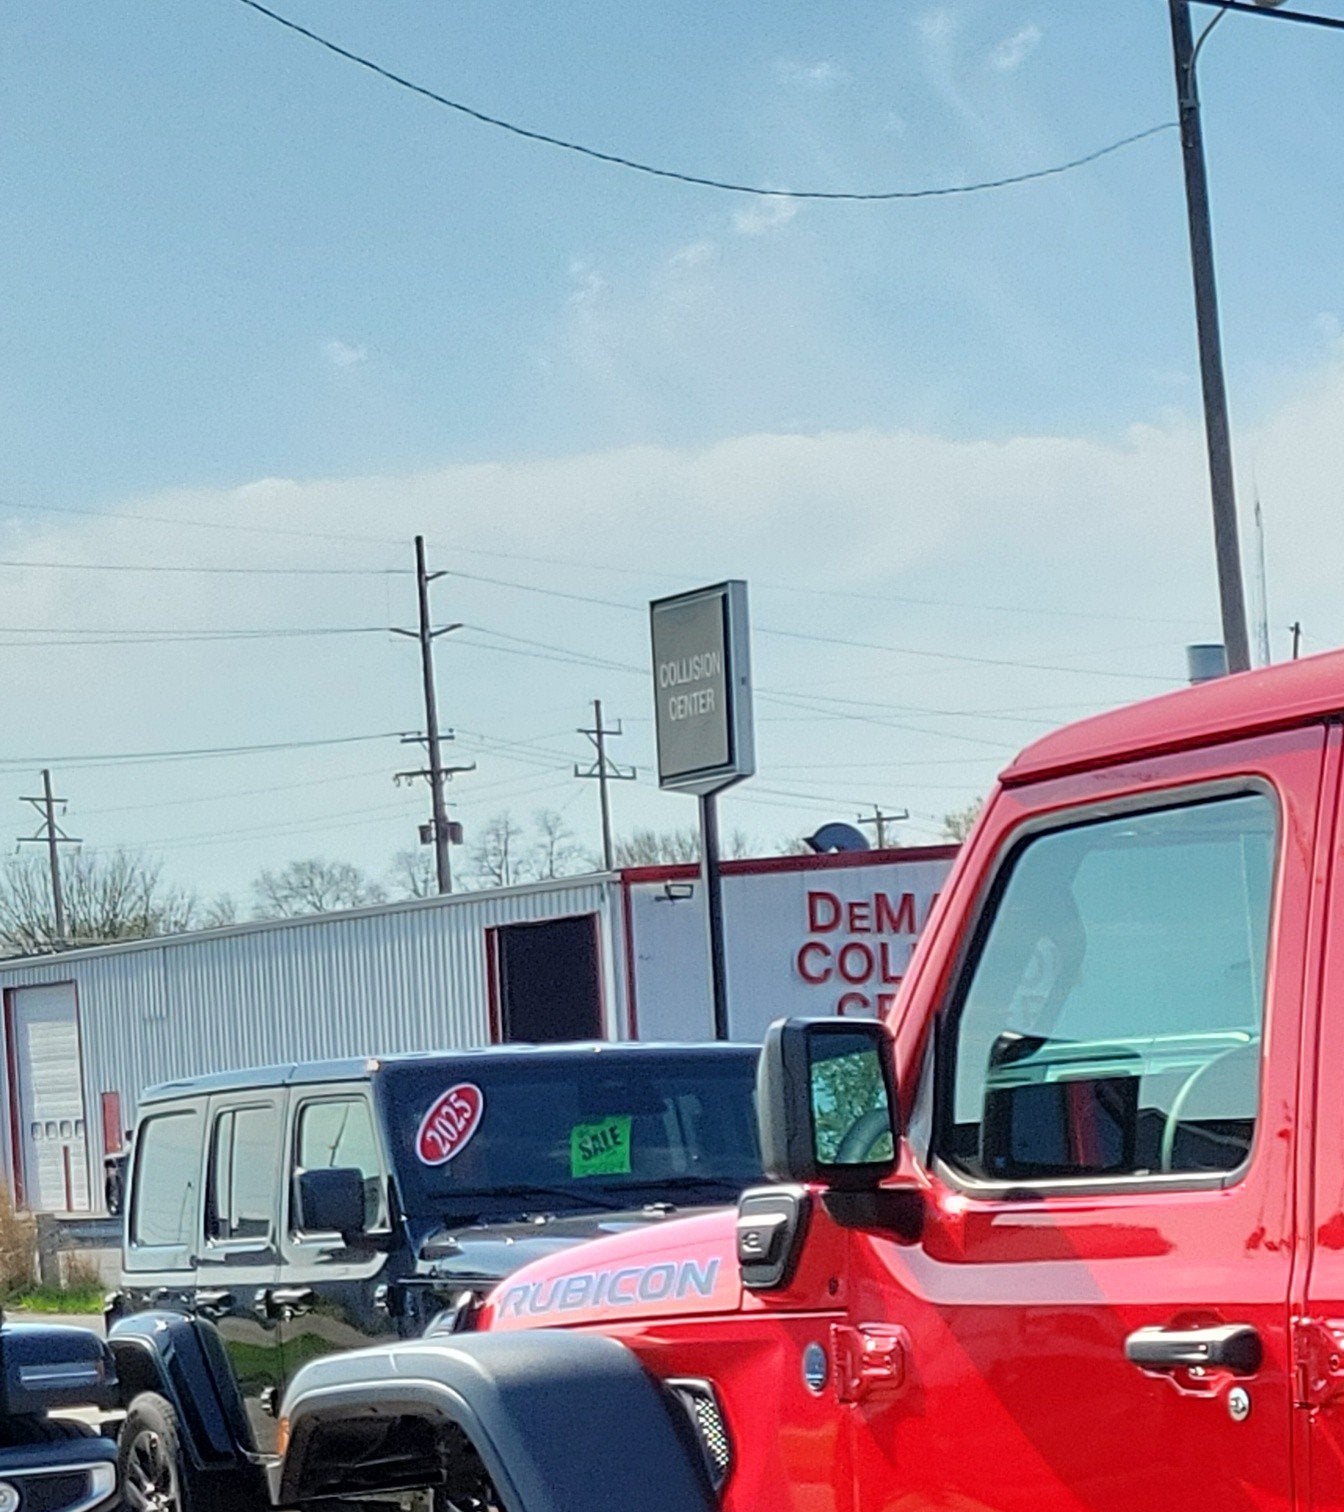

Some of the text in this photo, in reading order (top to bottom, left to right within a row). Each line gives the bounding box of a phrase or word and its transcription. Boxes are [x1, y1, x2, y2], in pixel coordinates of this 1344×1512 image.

[660, 650, 720, 688] COLLISION
[669, 688, 715, 721] CENTER
[797, 941, 917, 985] COL
[426, 1093, 472, 1156] 2025
[579, 1125, 623, 1161] SALE
[498, 1256, 723, 1320] RUBICON
